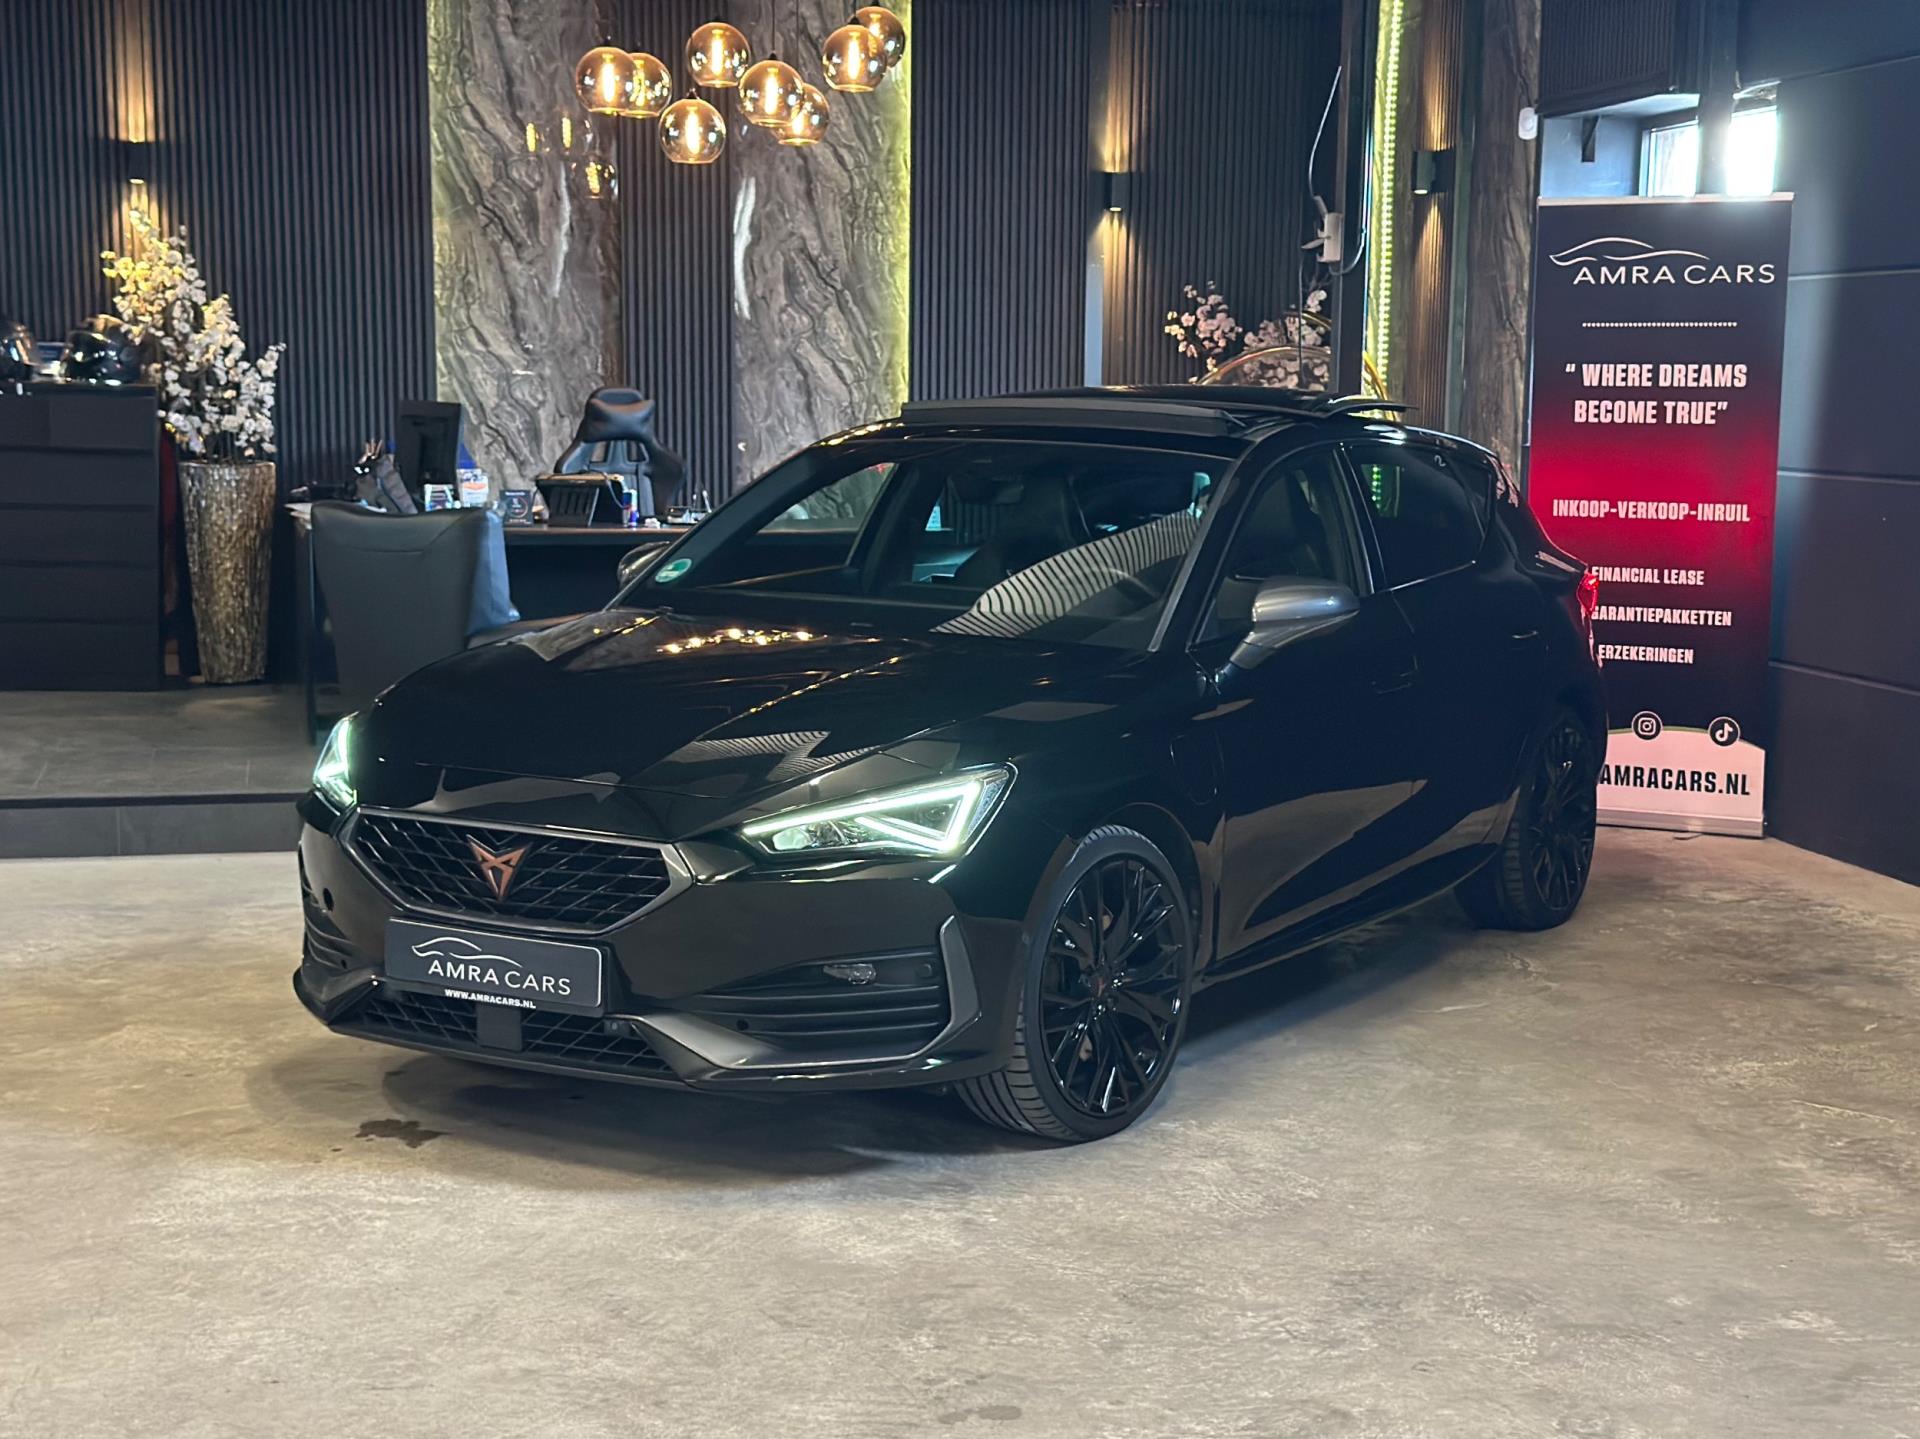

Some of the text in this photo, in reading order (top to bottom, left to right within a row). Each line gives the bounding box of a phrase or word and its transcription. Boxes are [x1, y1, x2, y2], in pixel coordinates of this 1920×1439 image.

[1573, 263, 1776, 285] AMRA CARS
[1582, 363, 1653, 387] WHERE
[1658, 363, 1748, 388] DREAMS
[1574, 399, 1657, 424] BECOME
[1552, 498, 1751, 522] INKOOP-VERKOOP-INRUIL
[1663, 569, 1705, 586] LEASE
[1598, 644, 1694, 664] ERZEKERINGEN
[1600, 763, 1751, 796] AMRACARS.NL
[428, 959, 572, 996] AMRA CARS
[444, 988, 537, 1010] WWW.AMRACARS.NL
